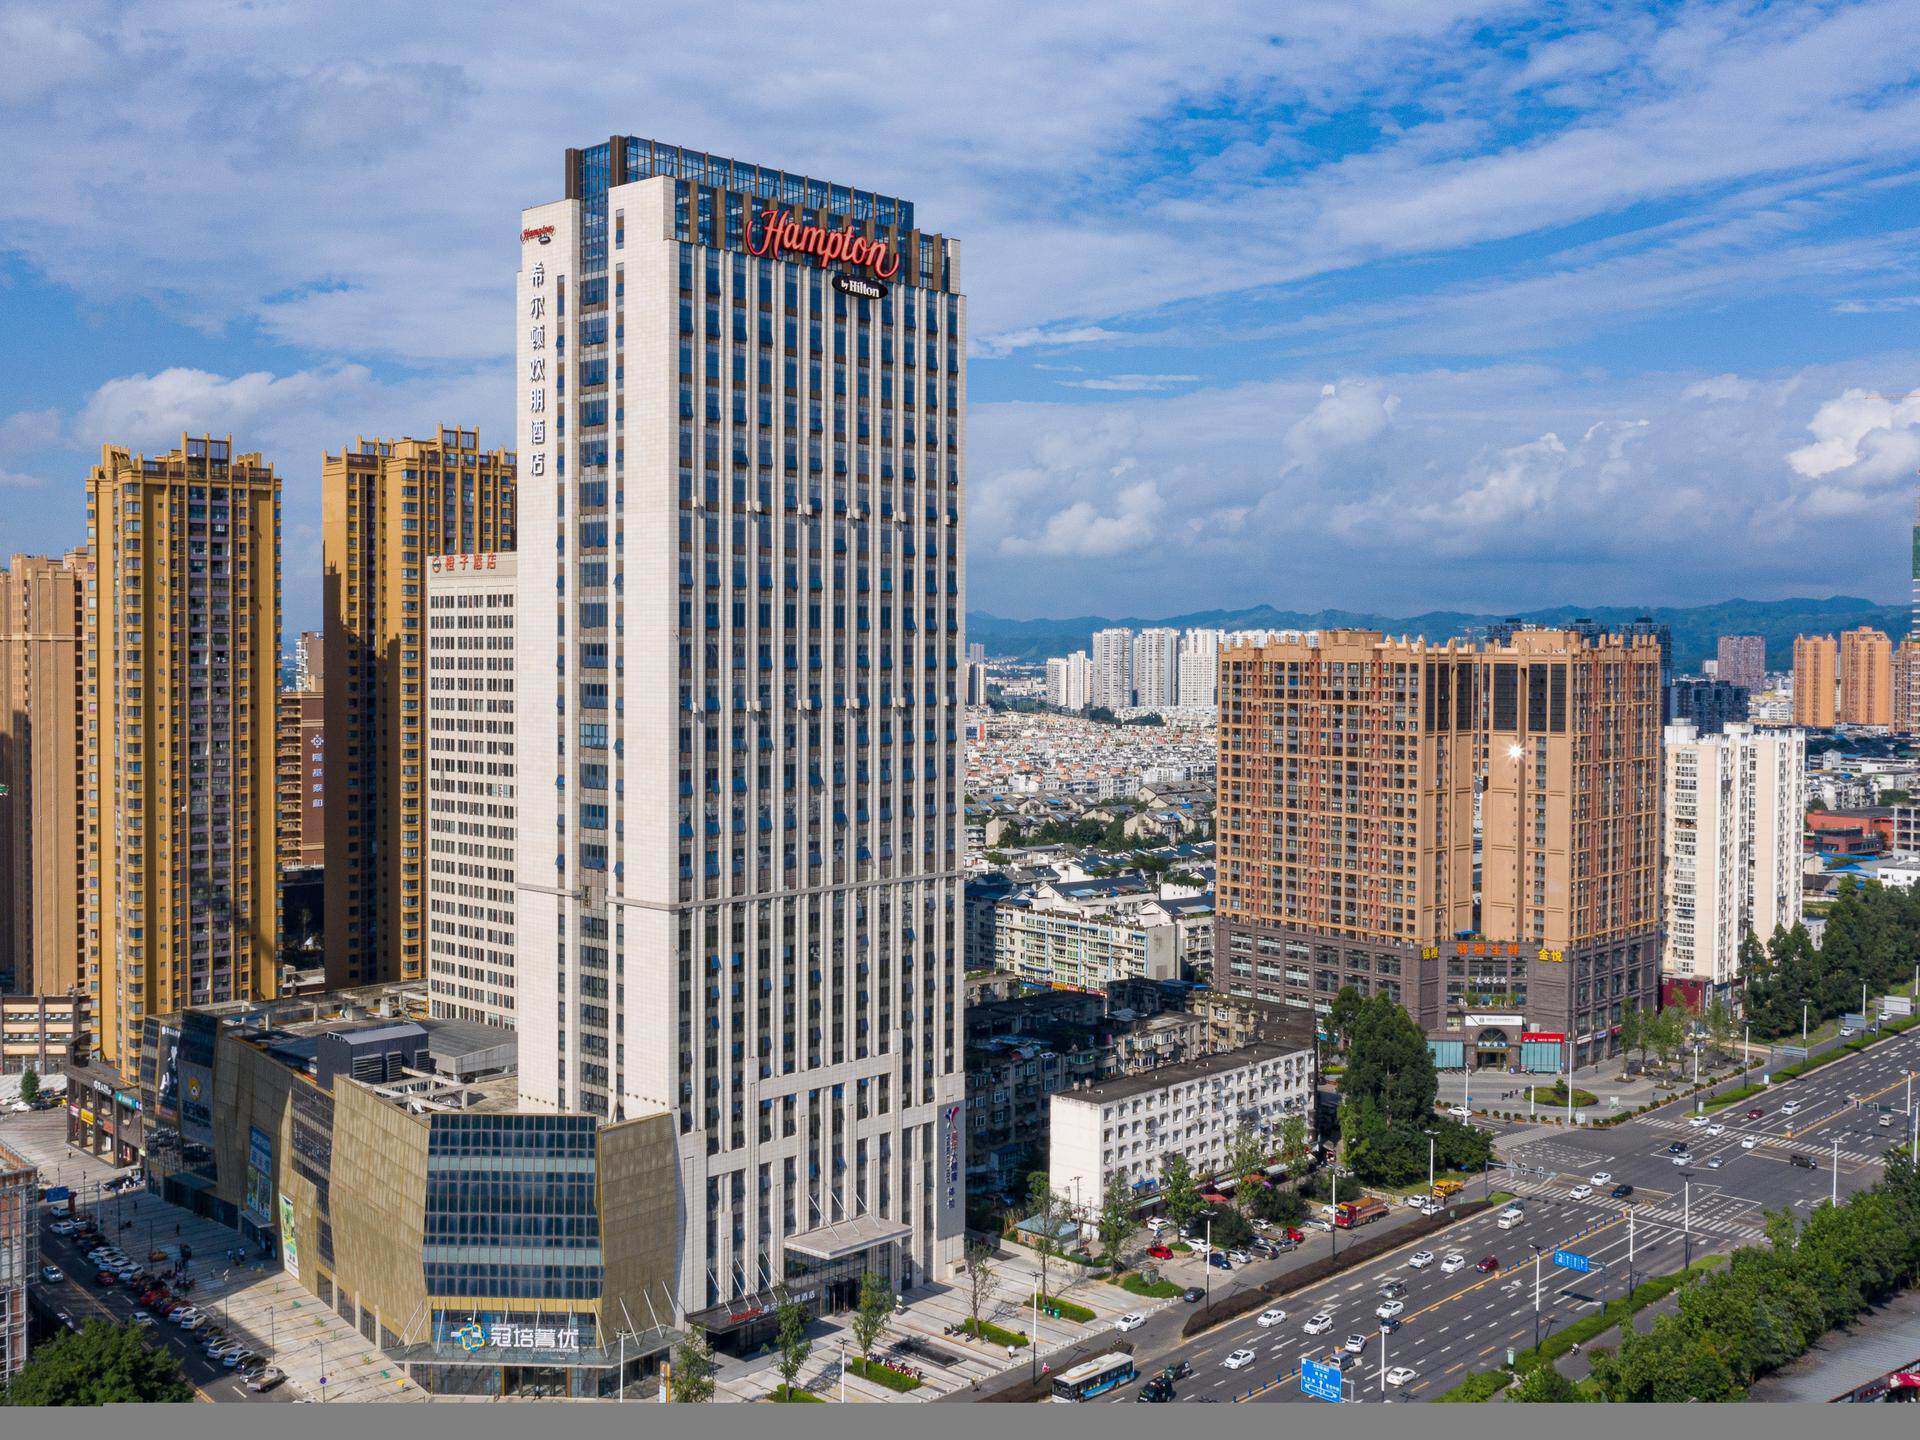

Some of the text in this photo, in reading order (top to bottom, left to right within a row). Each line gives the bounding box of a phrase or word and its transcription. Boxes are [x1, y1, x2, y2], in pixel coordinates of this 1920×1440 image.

[745, 209, 900, 279] Hampton
[841, 280, 880, 298] by Hilton
[530, 262, 546, 476] 希尔顿欢朋酒店
